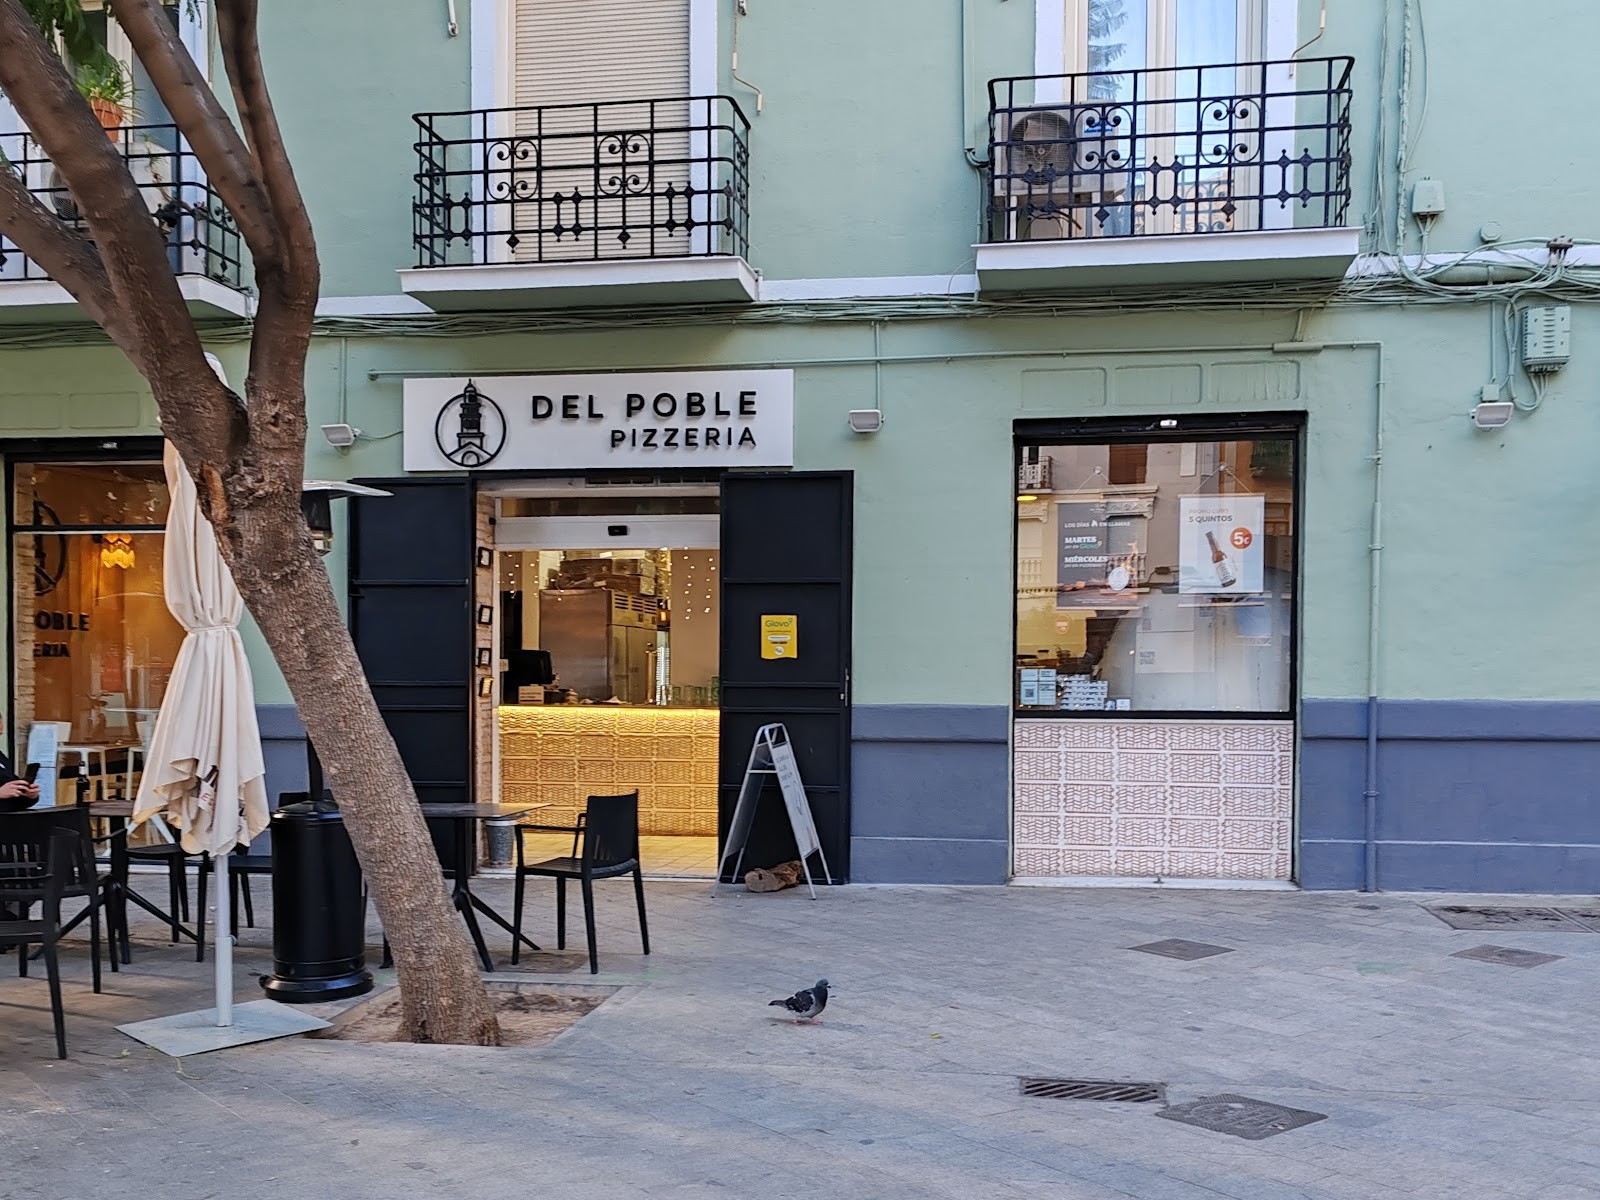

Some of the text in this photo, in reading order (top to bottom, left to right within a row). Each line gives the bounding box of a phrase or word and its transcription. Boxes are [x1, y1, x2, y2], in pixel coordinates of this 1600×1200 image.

[532, 391, 757, 419] DEL POBLE
[611, 427, 756, 448] PIZZERIA
[1195, 515, 1233, 523] QUINTOS
[1064, 555, 1108, 563] MIÉRCOLES
[35, 609, 90, 631] OBLE
[33, 641, 71, 657] ERIA
